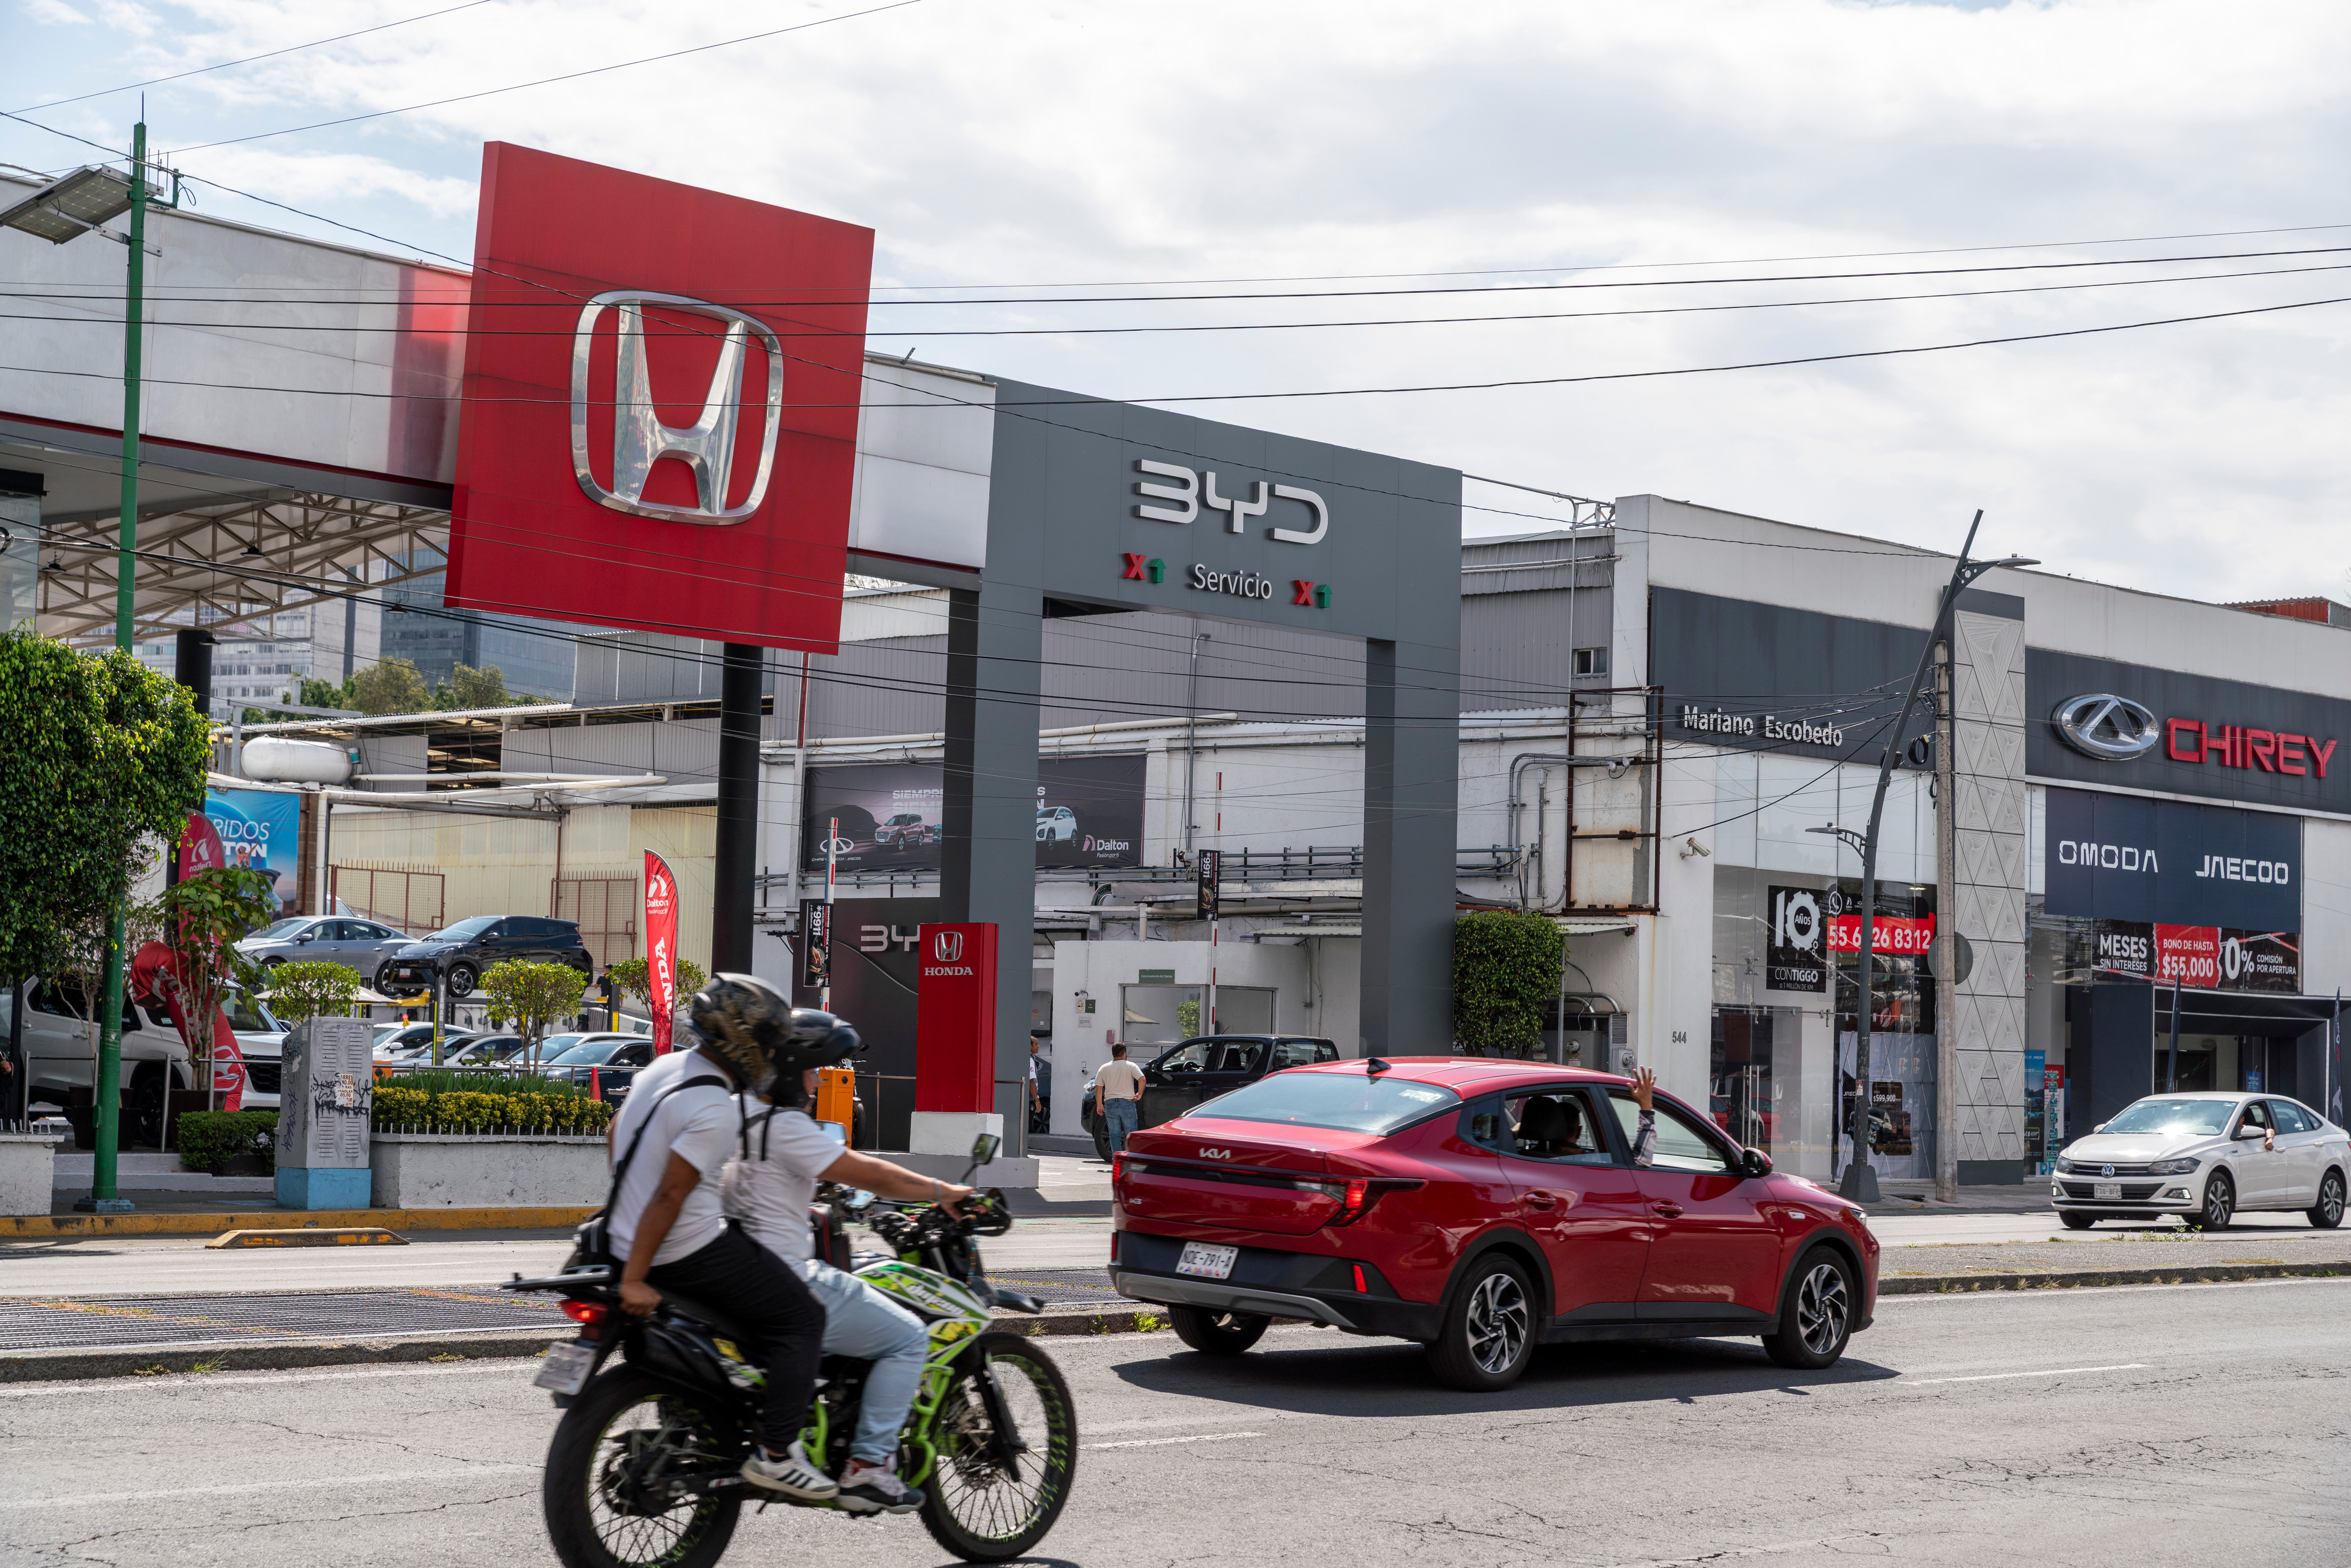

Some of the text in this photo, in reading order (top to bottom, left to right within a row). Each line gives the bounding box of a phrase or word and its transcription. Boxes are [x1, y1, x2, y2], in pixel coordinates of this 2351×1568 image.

[1136, 459, 1328, 544] BYD
[1194, 564, 1272, 599] Servicio
[1685, 705, 1842, 746] Mariano Escobedo
[2166, 718, 2337, 778] CHIREY
[214, 819, 270, 840] RIDOS
[223, 841, 267, 857] TON
[1097, 839, 1128, 850] Dalton
[2059, 841, 2288, 884] OMODA JAECOO
[647, 899, 669, 907] Dalton
[1794, 915, 1812, 926] AÑOS
[860, 925, 920, 951] BY
[1830, 926, 1931, 949] 55 626 8312
[2163, 938, 2214, 951] BONO DE HASTA
[2100, 934, 2147, 959] MESES
[2100, 958, 2111, 968] SIN
[2113, 959, 2147, 971] INTERESES
[2162, 952, 2213, 981] $55,000
[2257, 953, 2283, 964] COMISIÓN
[924, 967, 974, 976] HONDA
[2257, 965, 2296, 974] POR APERTURA
[655, 937, 673, 1024] NDA
[1672, 1031, 1687, 1044] 544
[1873, 1094, 1895, 1103] $599,900
[2040, 1162, 2056, 1176] PH
